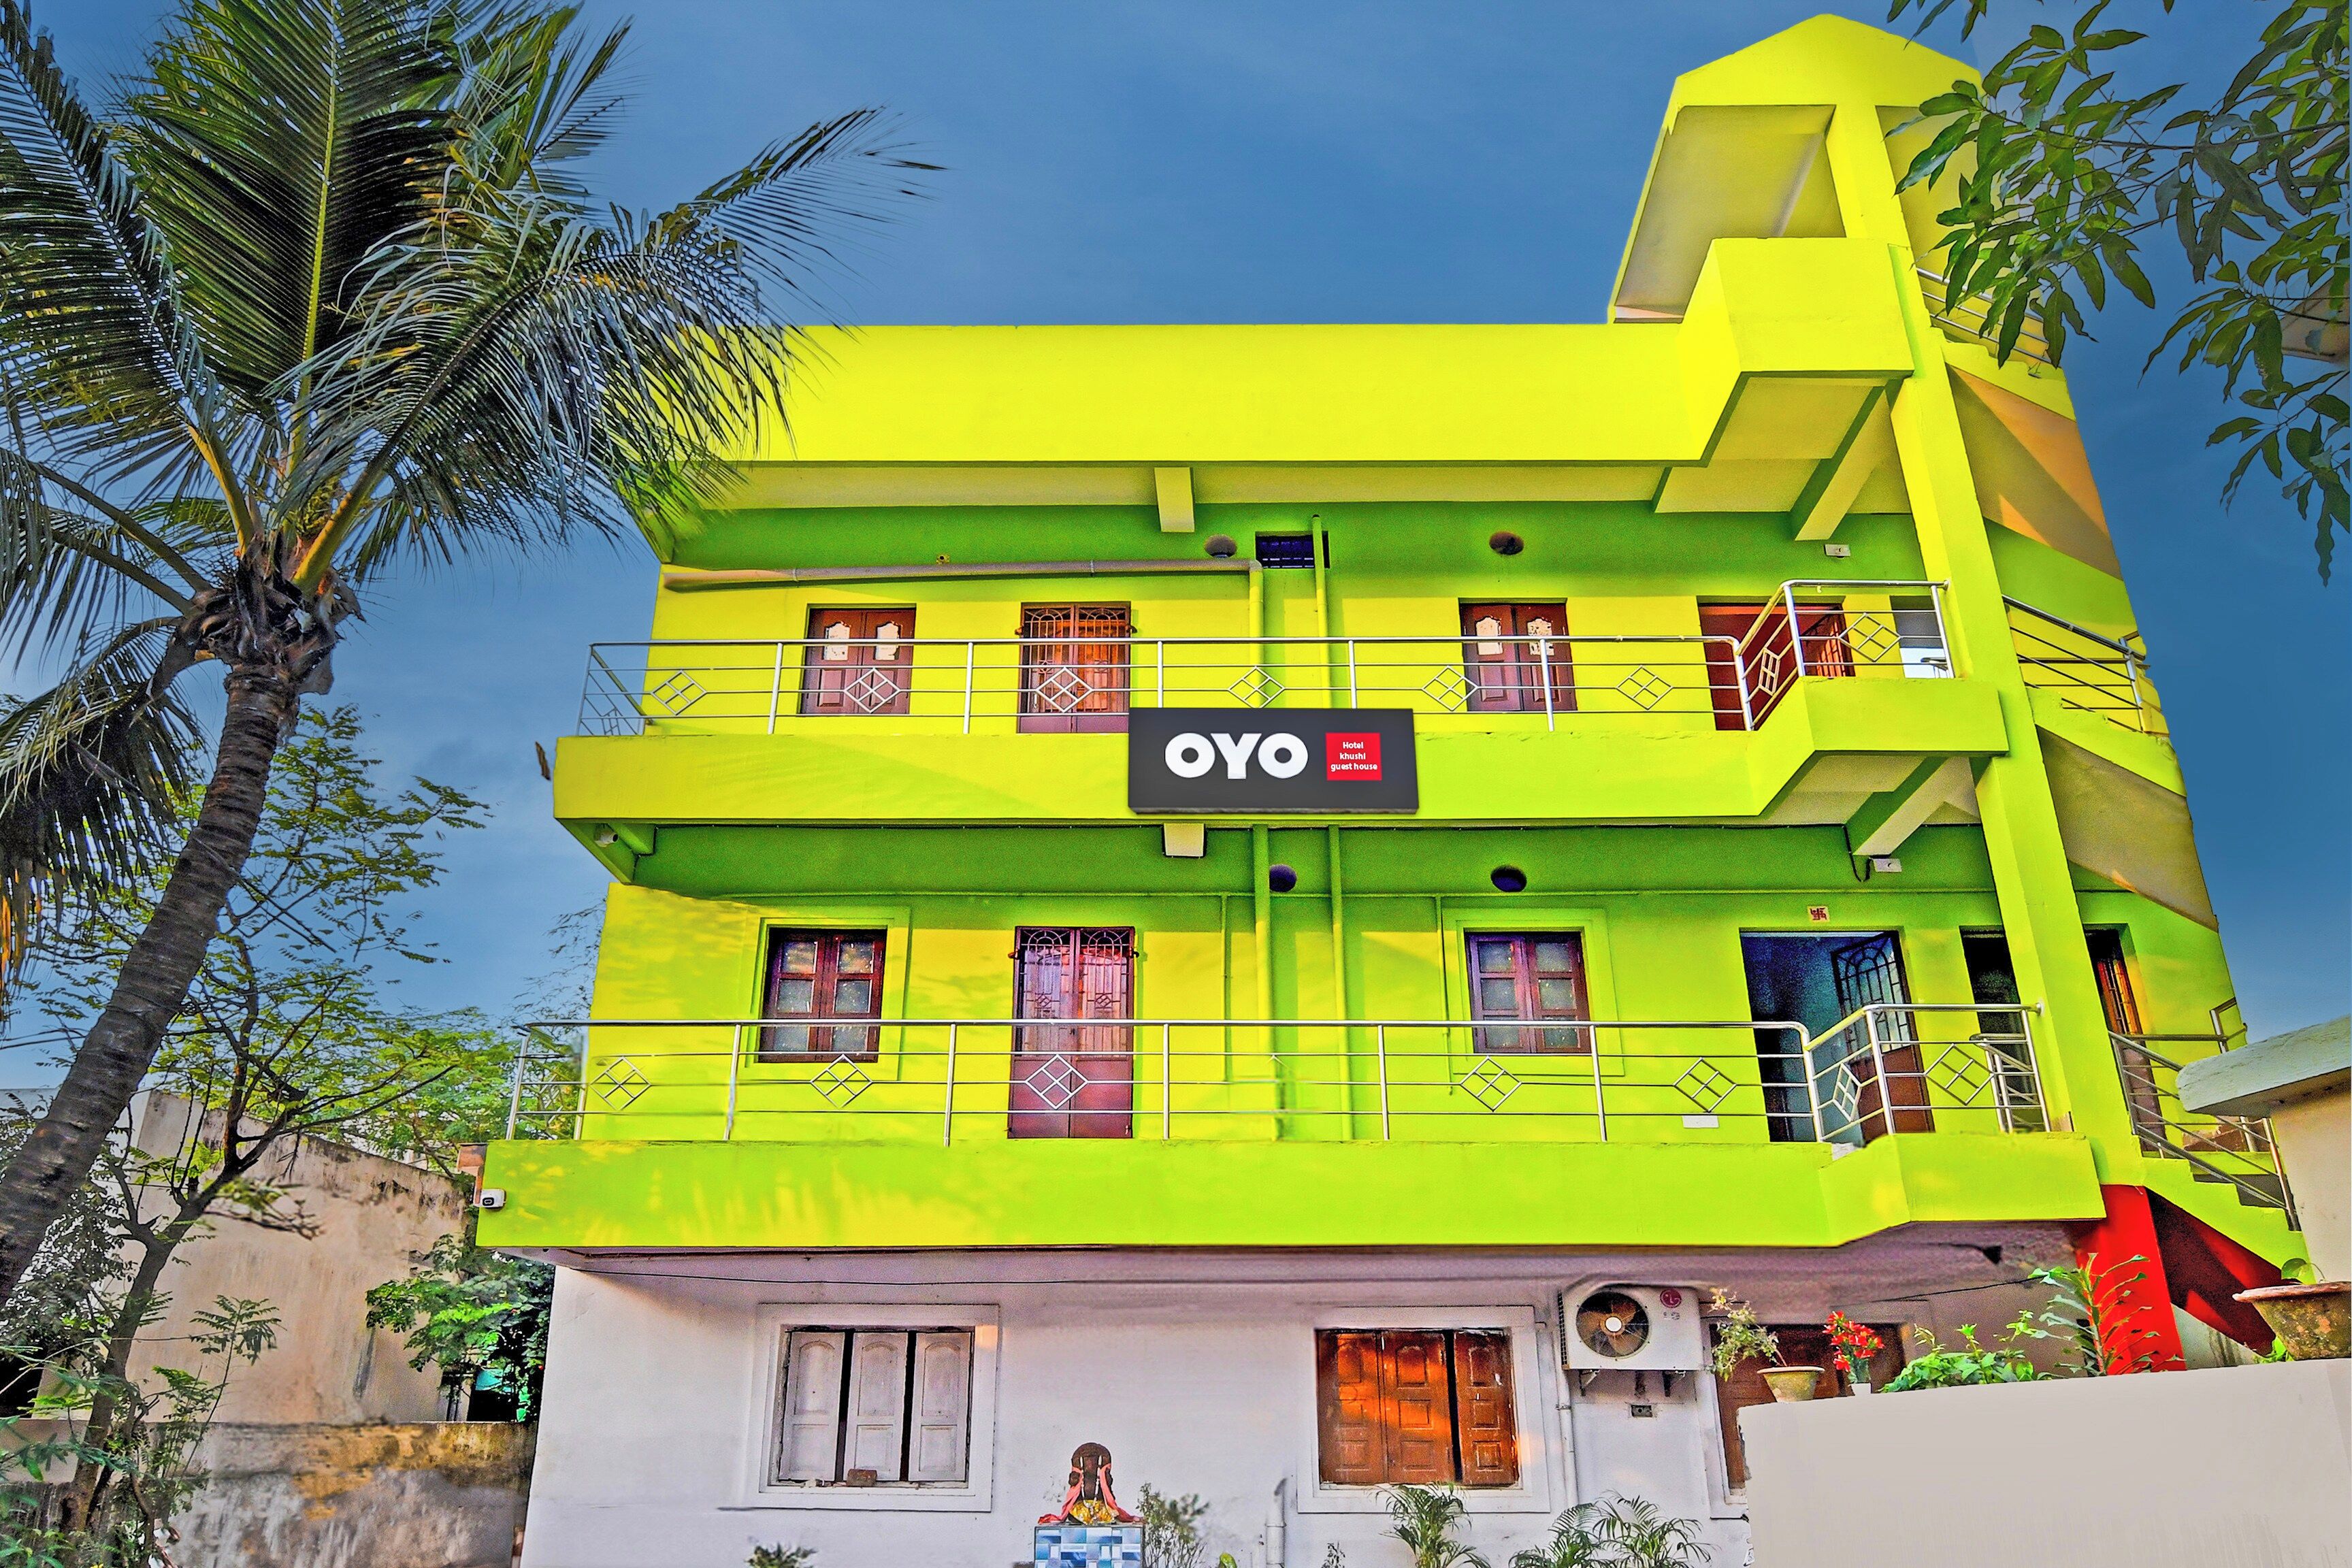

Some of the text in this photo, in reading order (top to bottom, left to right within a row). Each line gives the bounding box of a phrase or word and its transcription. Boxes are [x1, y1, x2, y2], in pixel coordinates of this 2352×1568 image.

[1342, 741, 1364, 749] Hotel
[1164, 732, 1309, 780] OYO
[1339, 752, 1367, 760] khushi
[1330, 762, 1378, 772] guest house
